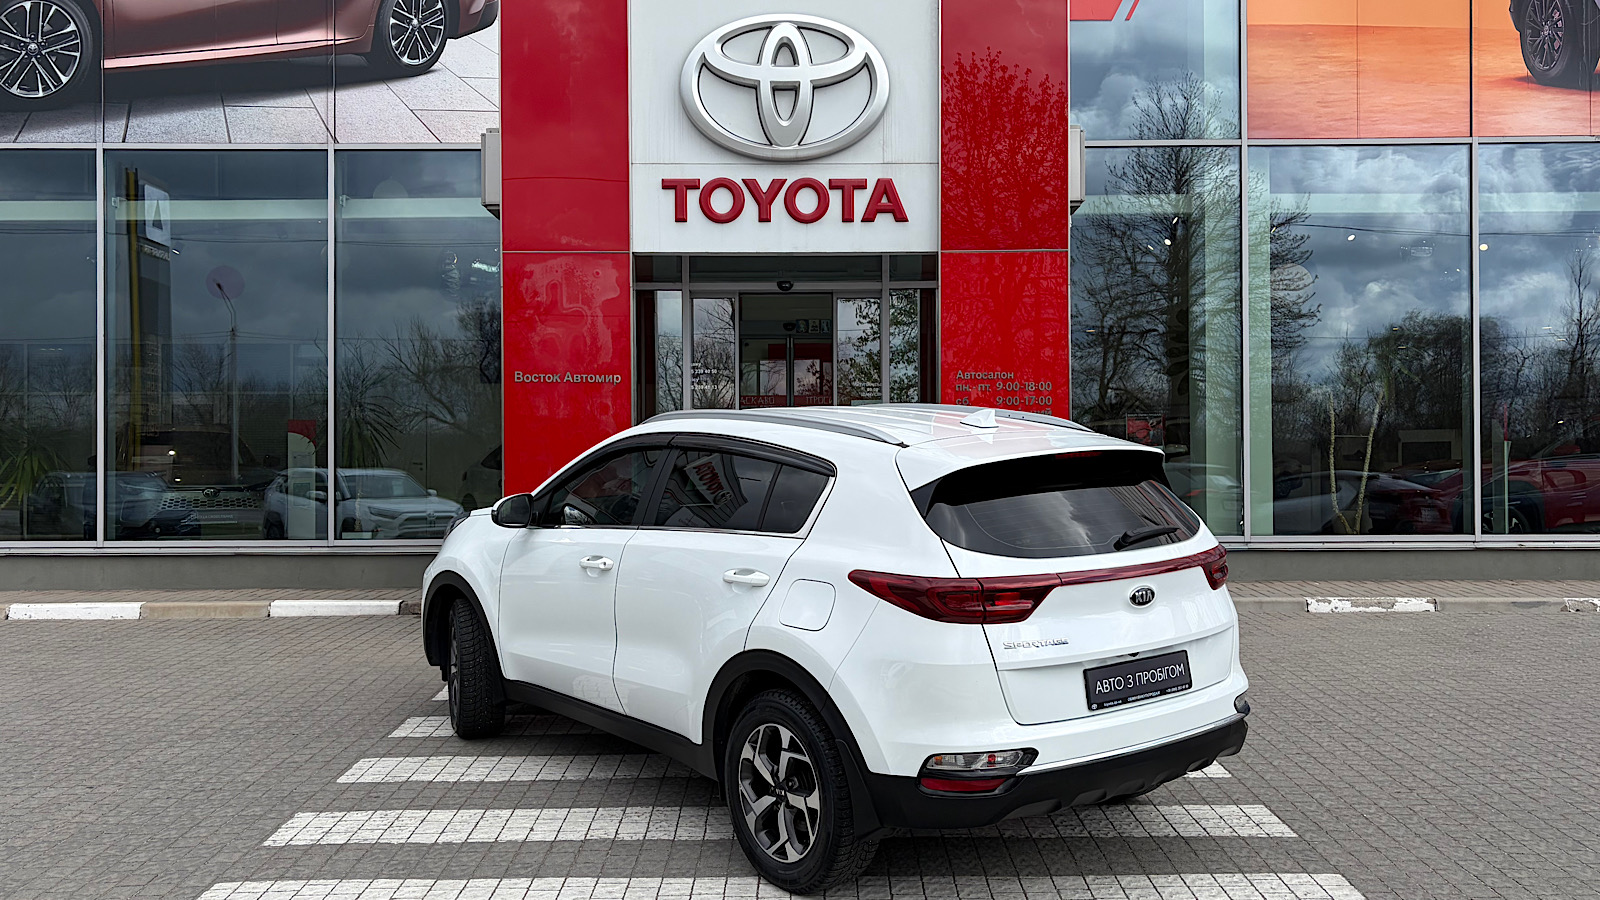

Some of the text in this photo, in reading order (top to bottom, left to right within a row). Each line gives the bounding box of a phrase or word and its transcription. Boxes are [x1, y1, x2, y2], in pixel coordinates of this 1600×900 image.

[661, 177, 909, 224] TOYOTA
[514, 371, 622, 386] Восток Автомир
[956, 370, 1015, 380] Автосалон
[996, 382, 1052, 391] 9:00-18:00
[996, 396, 1053, 406] 9:00-17:00
[1135, 590, 1153, 603] KIA
[1002, 637, 1069, 650] SPORTAGE
[1095, 676, 1124, 695] АВТО
[1135, 662, 1185, 686] ПРОБІГОМ
